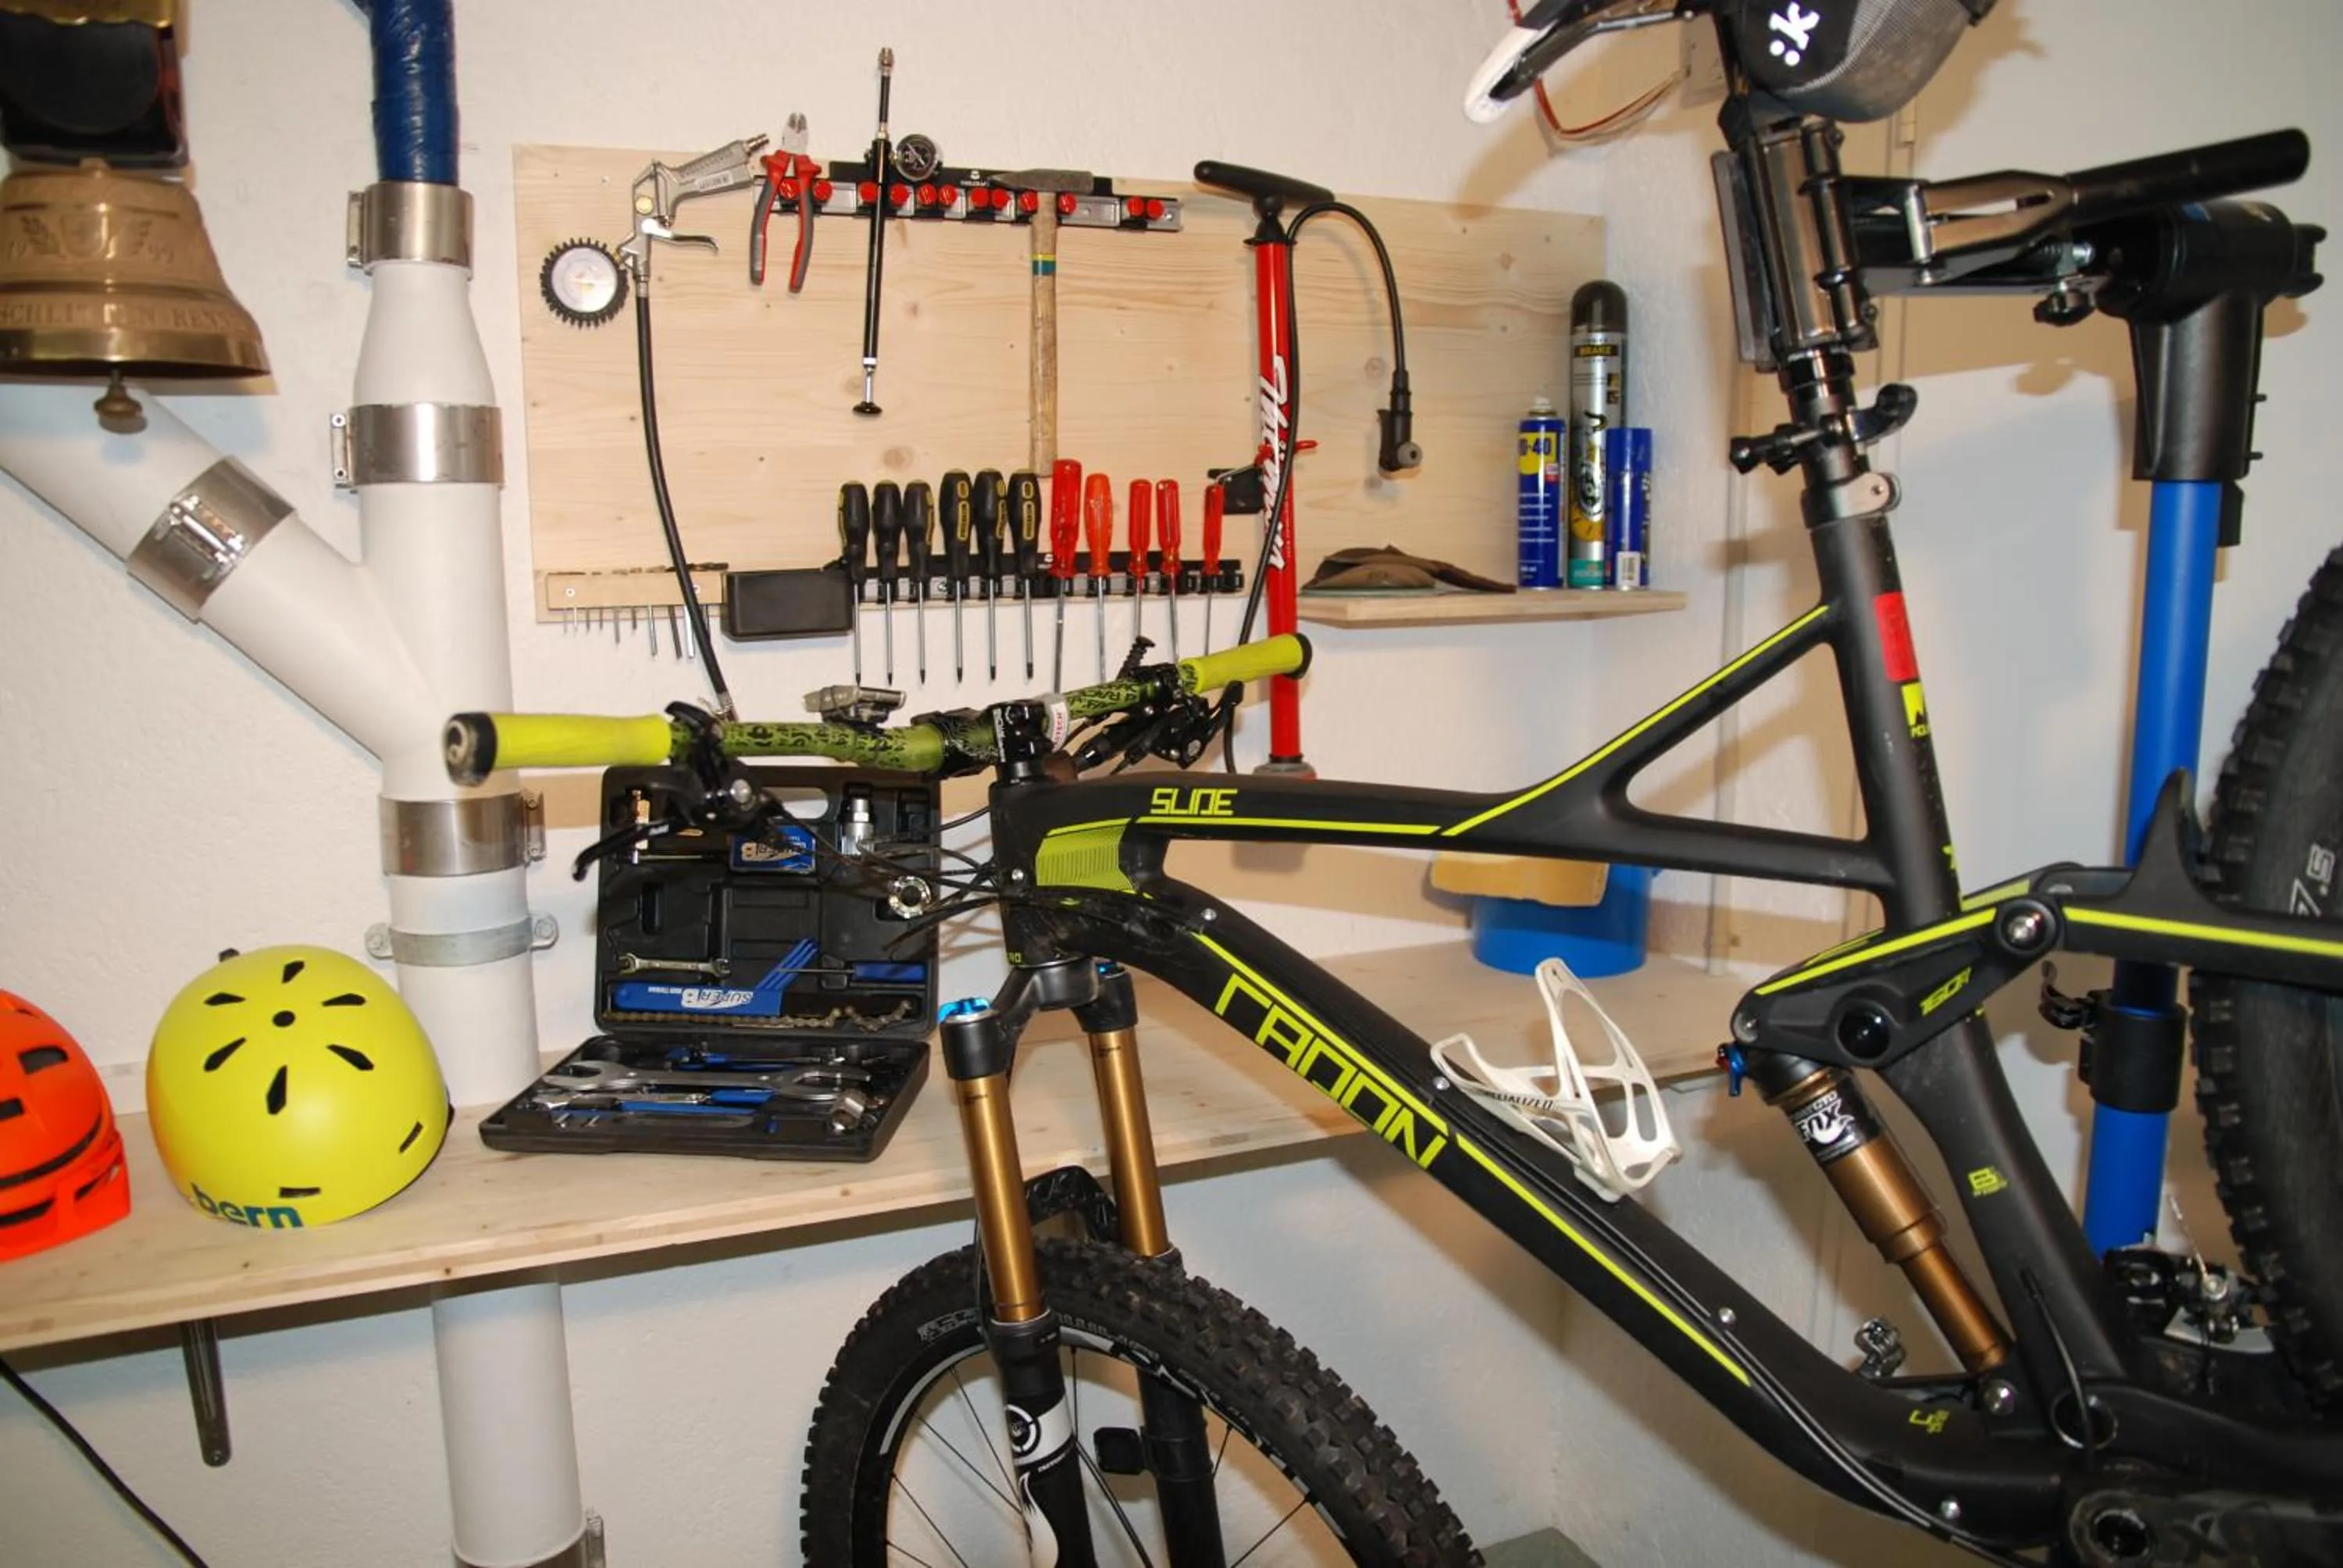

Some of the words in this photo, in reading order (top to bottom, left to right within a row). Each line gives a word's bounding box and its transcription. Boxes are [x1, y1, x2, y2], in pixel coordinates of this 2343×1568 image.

[1150, 788, 1238, 815] SLIDE
[1214, 972, 1447, 1170] RADON
[191, 1181, 304, 1228] bern
